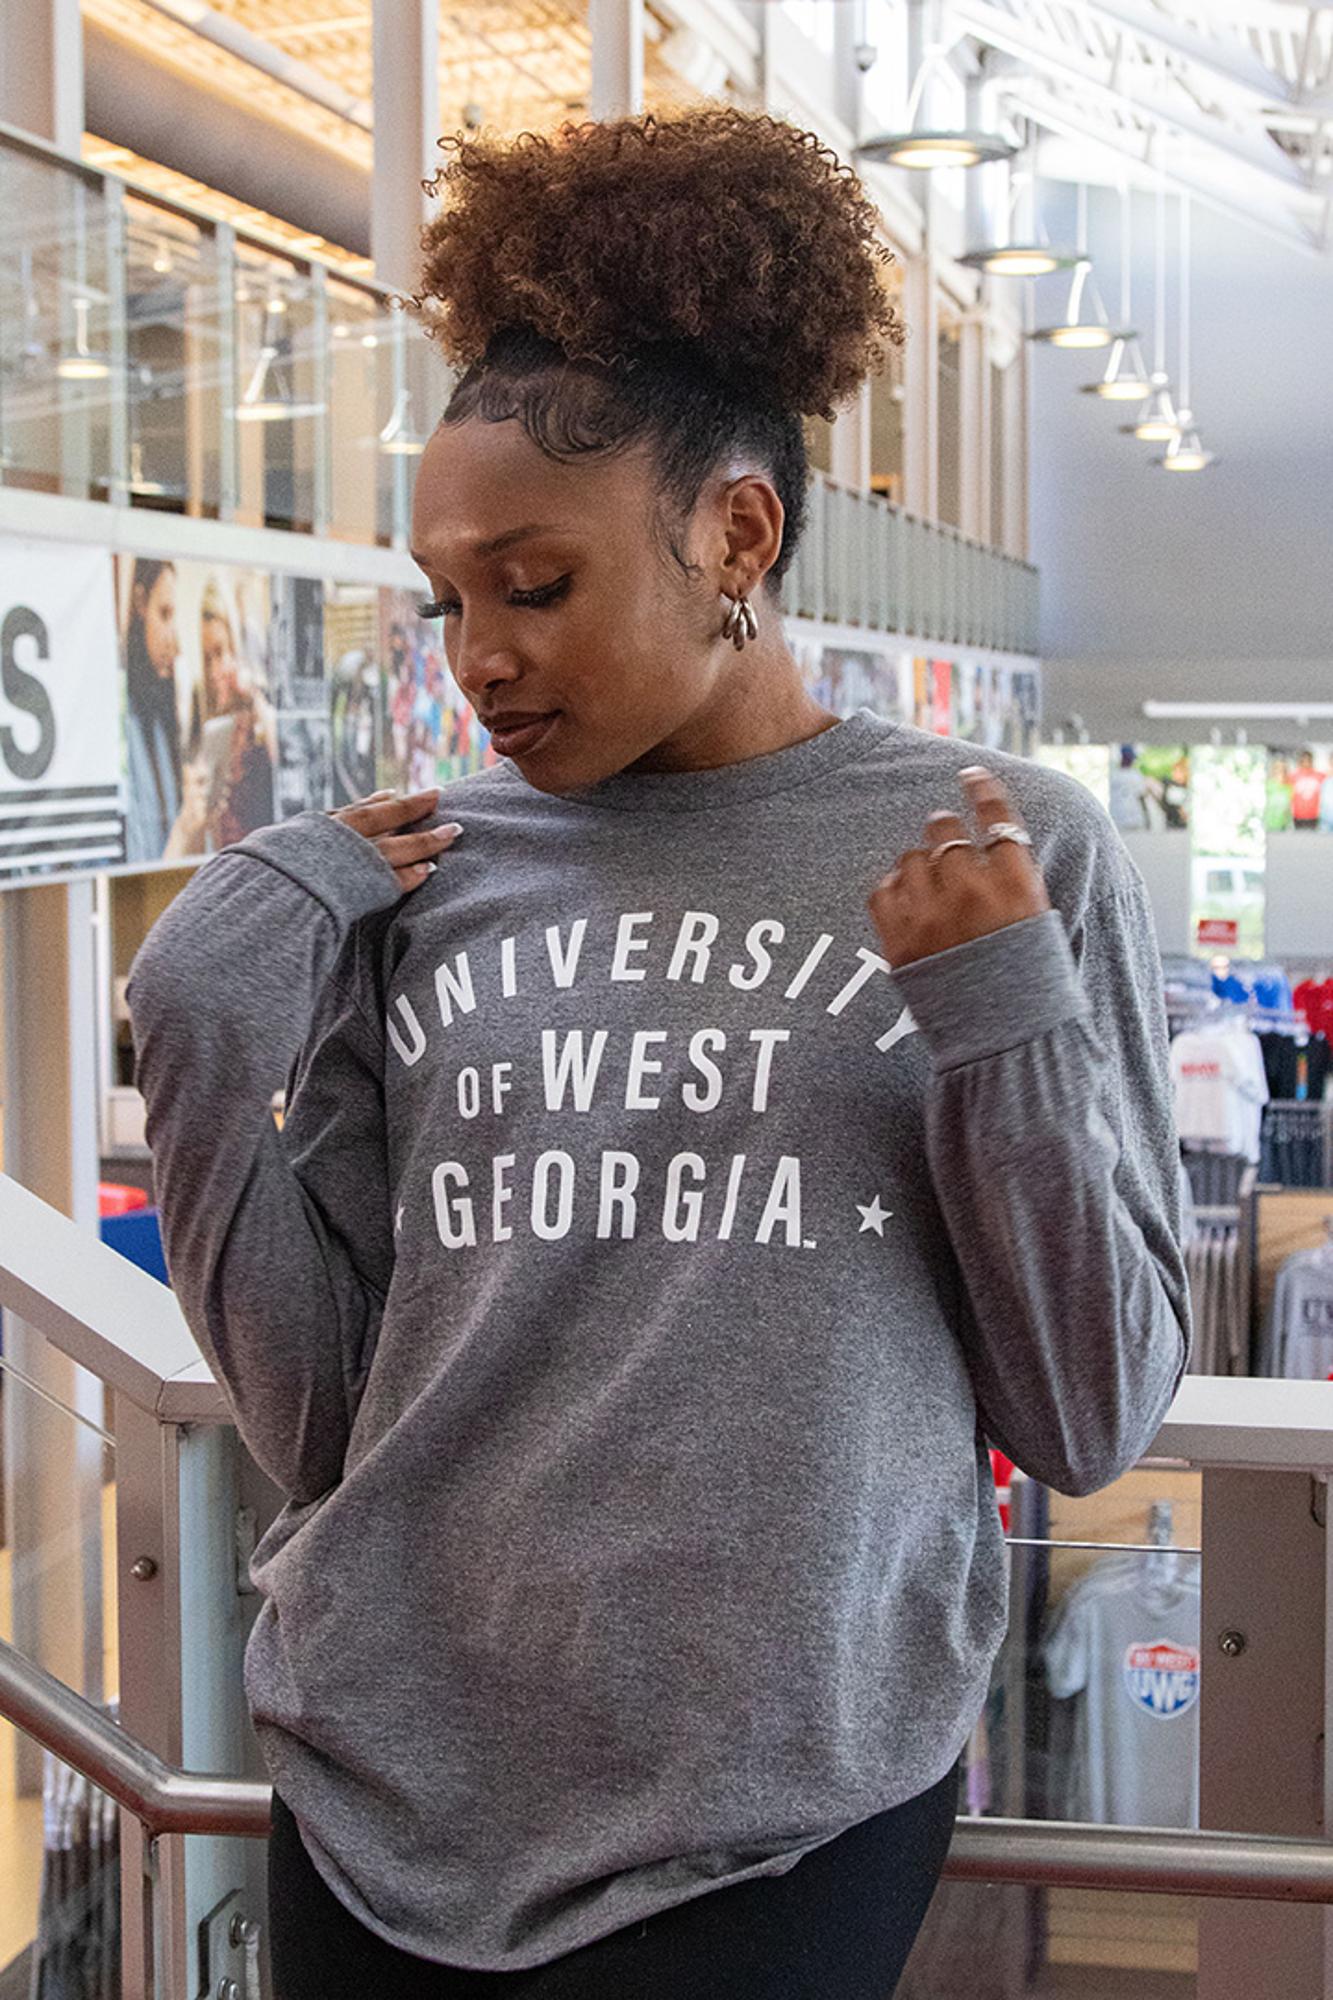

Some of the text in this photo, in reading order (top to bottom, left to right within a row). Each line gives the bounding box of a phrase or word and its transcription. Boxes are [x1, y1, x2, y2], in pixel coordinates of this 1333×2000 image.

[457, 1028, 791, 1119] OF WEST
[432, 1149, 801, 1249] GEORGIA
[1130, 1671, 1197, 1713] UWG
